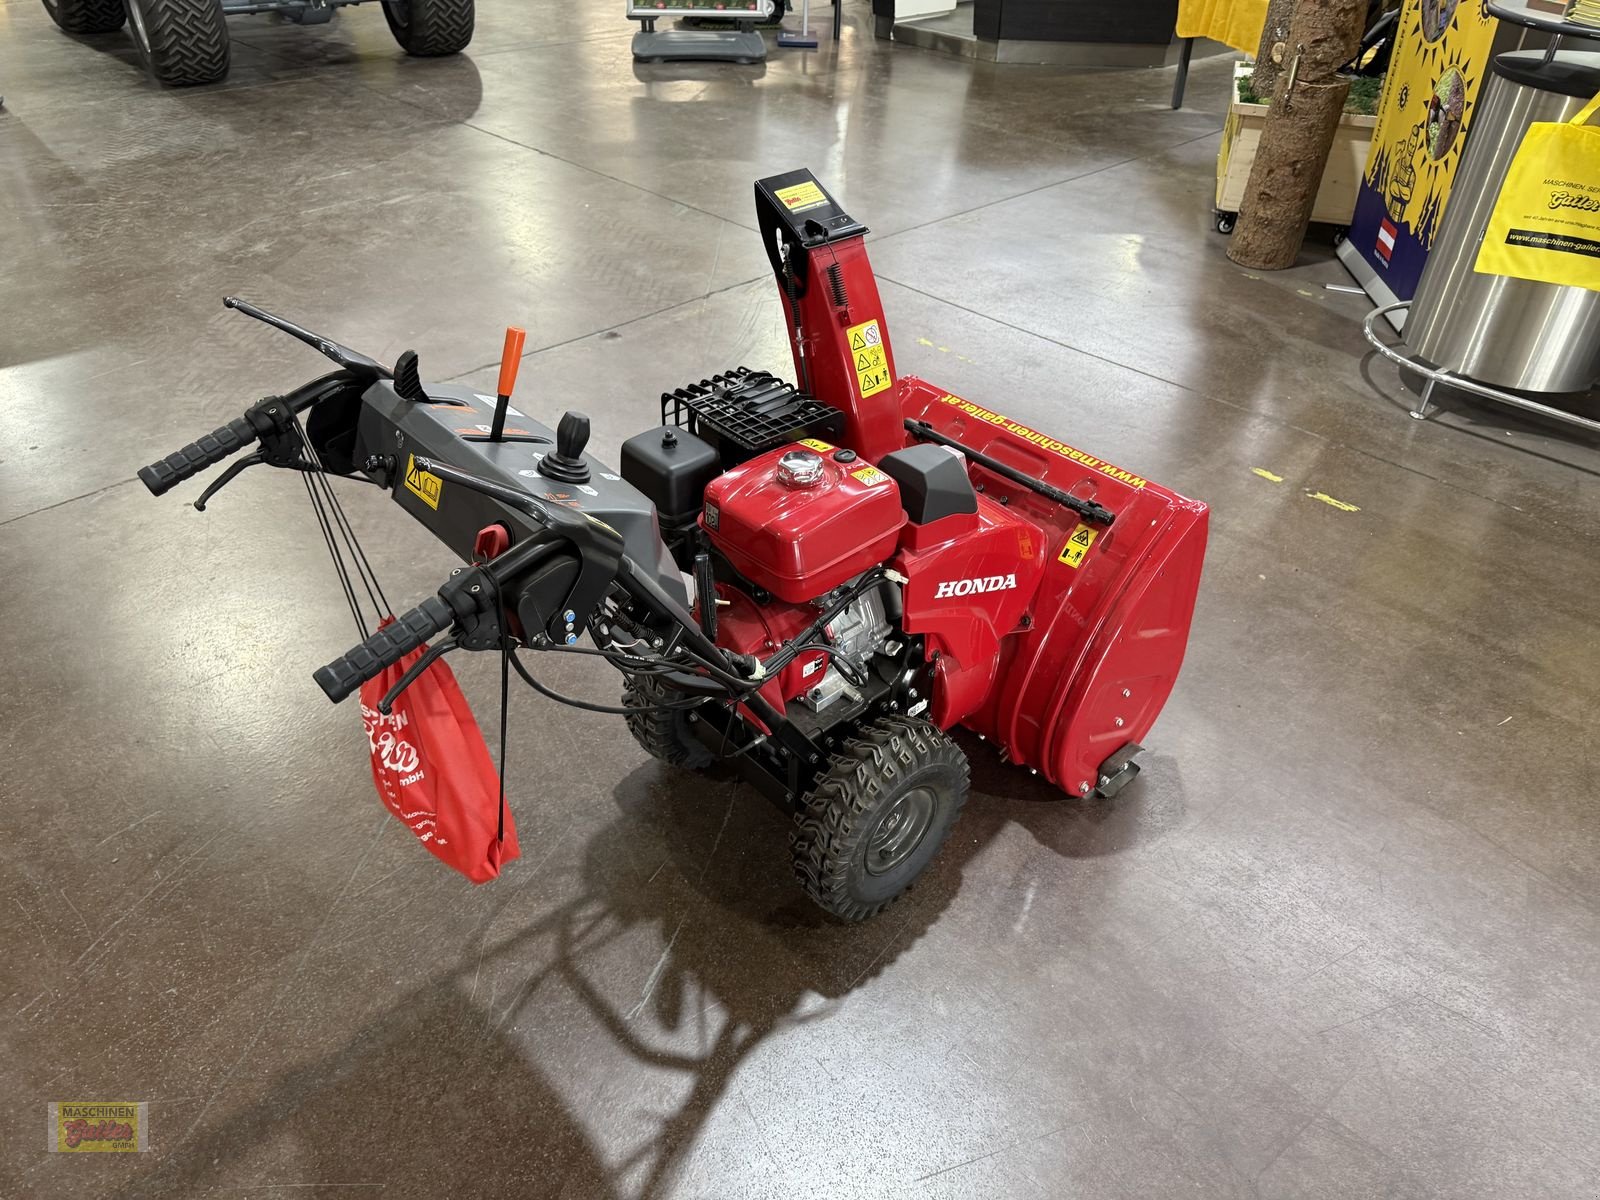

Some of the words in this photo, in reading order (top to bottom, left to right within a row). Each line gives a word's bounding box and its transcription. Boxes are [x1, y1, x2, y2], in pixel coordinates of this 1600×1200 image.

[1548, 190, 1600, 212] Gailer
[1509, 234, 1600, 253] www.maschinen-gailer.
[941, 394, 1148, 489] www.maschinen-gailer.at
[934, 573, 1017, 599] HONDA
